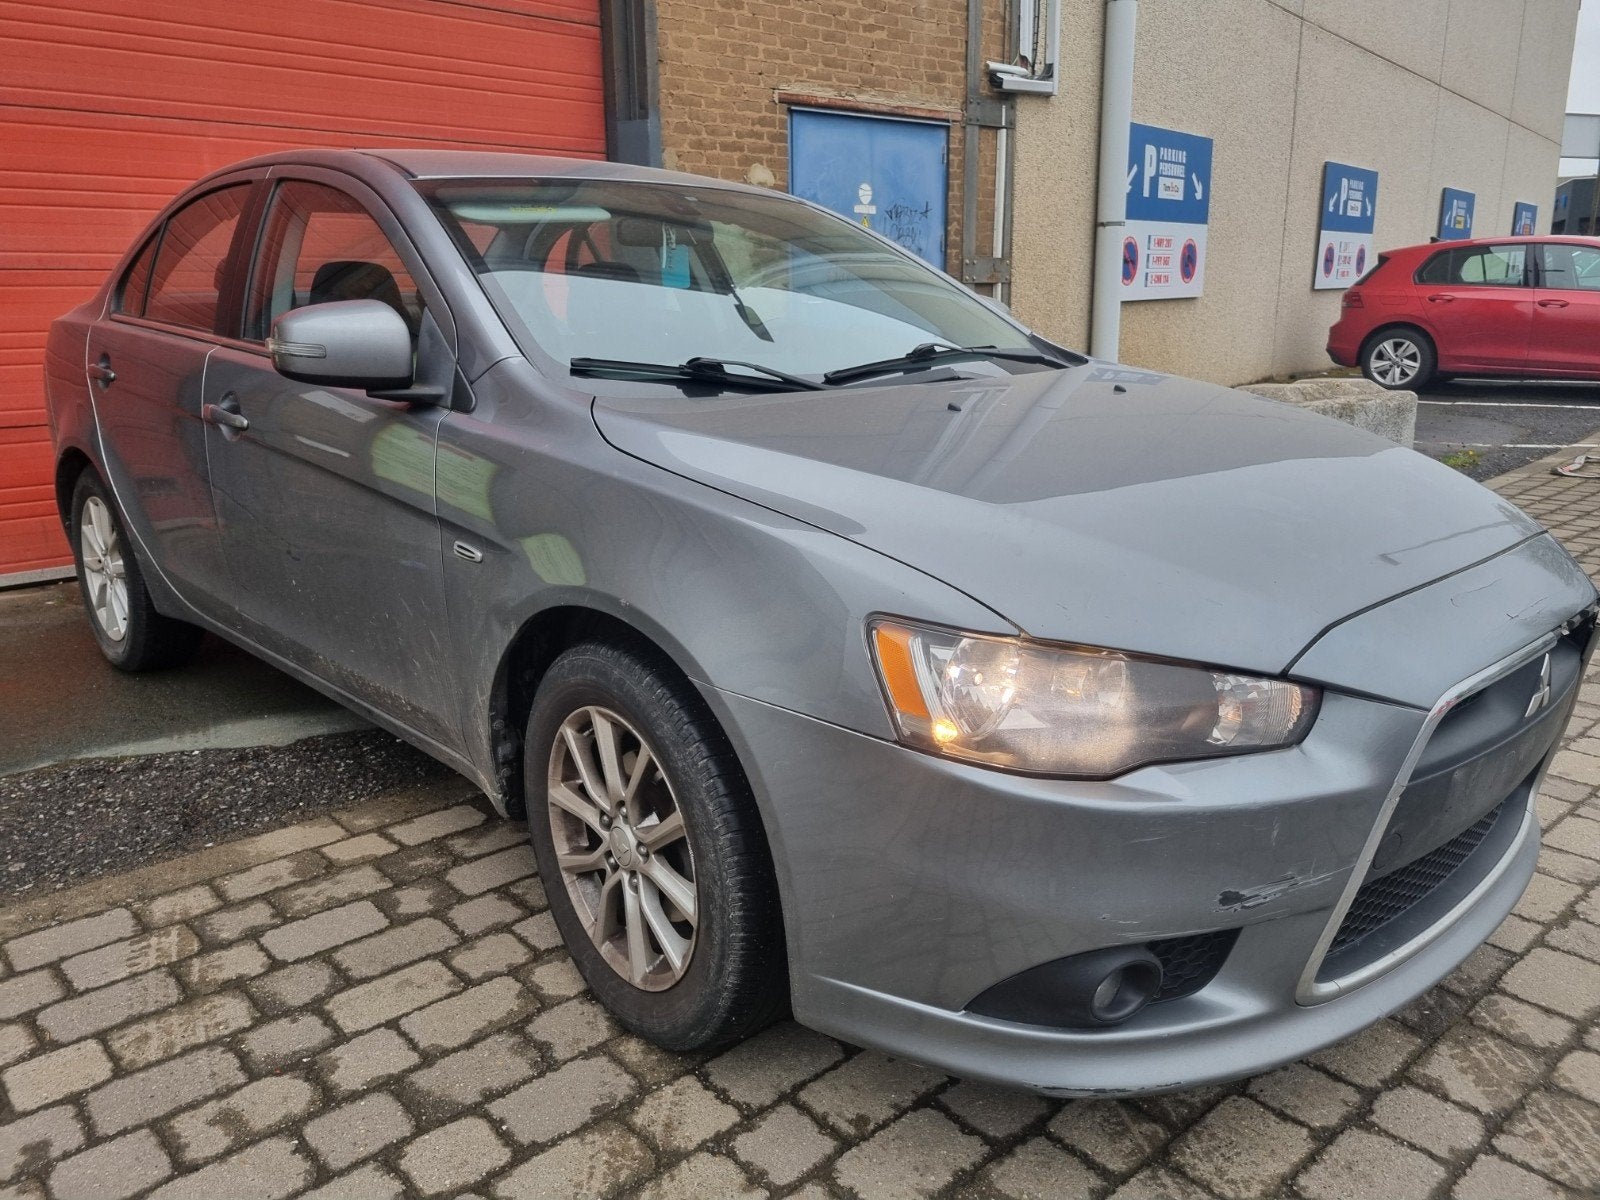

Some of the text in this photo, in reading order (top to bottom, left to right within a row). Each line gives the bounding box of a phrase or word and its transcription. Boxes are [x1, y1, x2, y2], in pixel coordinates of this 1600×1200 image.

[1143, 144, 1157, 197] P
[1160, 147, 1186, 163] PARKING
[1339, 177, 1348, 215] P
